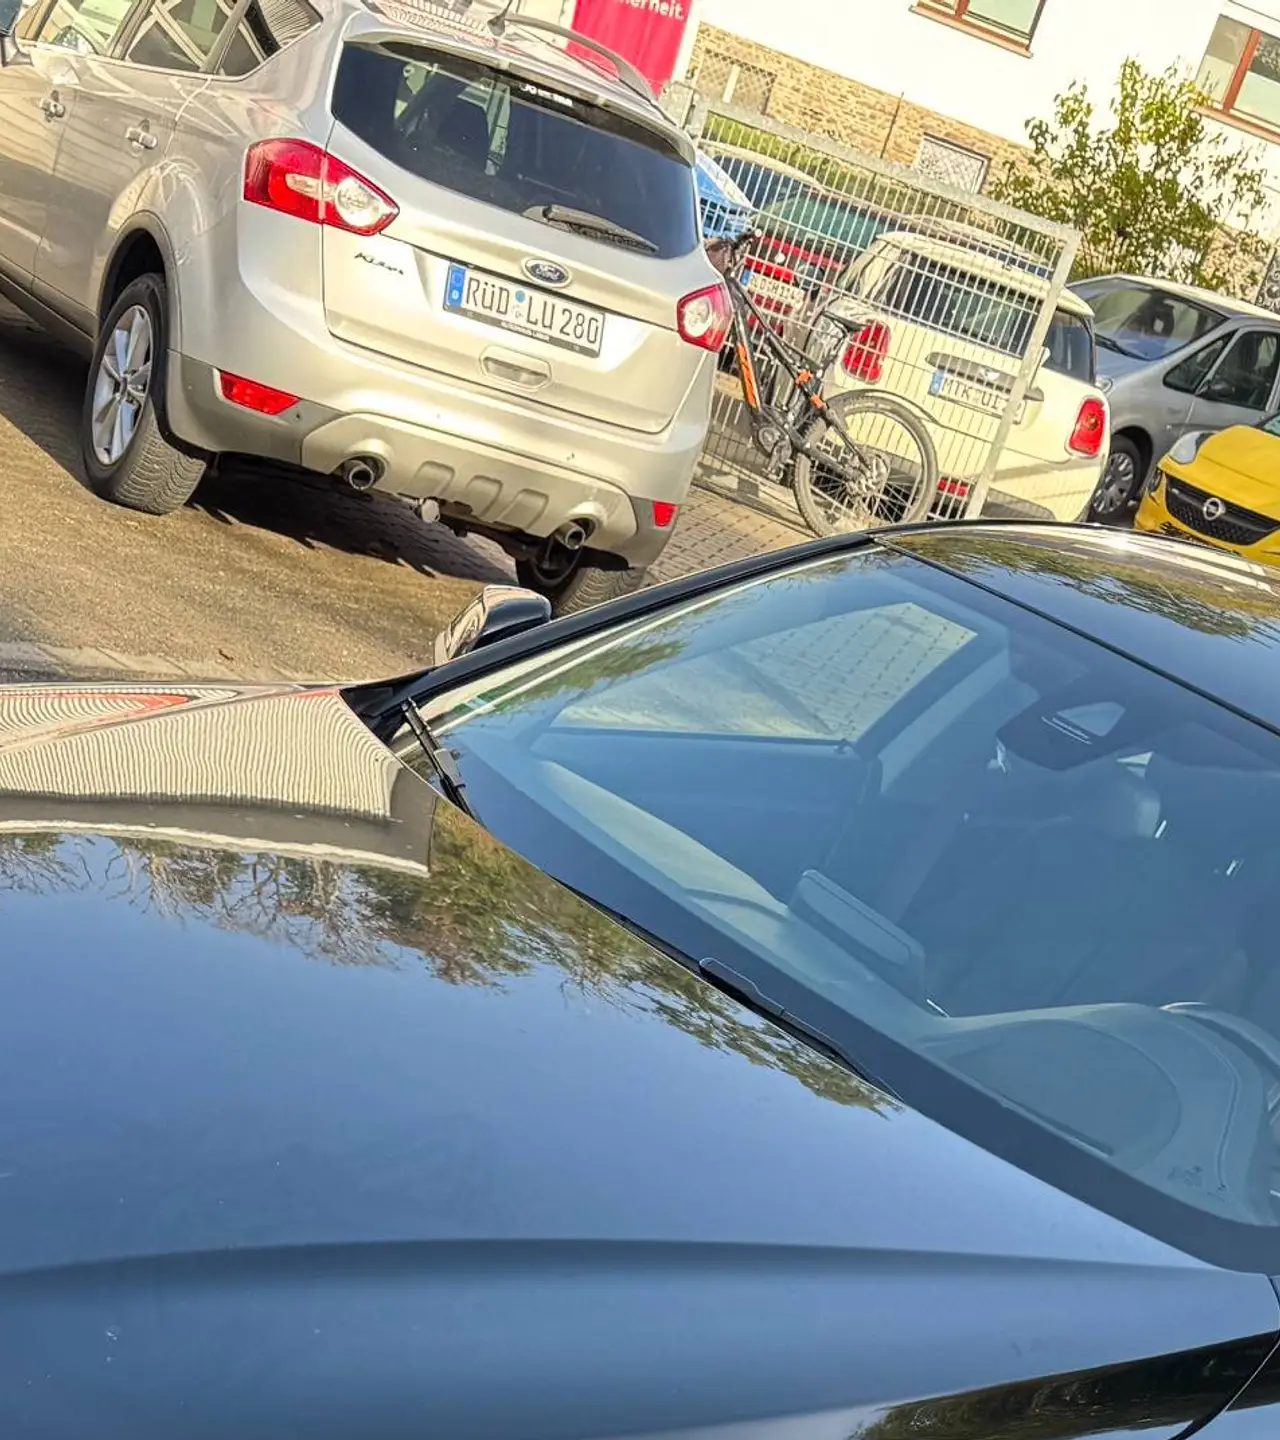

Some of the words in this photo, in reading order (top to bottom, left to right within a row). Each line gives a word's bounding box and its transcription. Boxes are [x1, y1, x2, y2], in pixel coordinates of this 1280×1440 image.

[624, 0, 685, 20] erheit.
[526, 295, 556, 331] LU
[558, 308, 600, 344] 280
